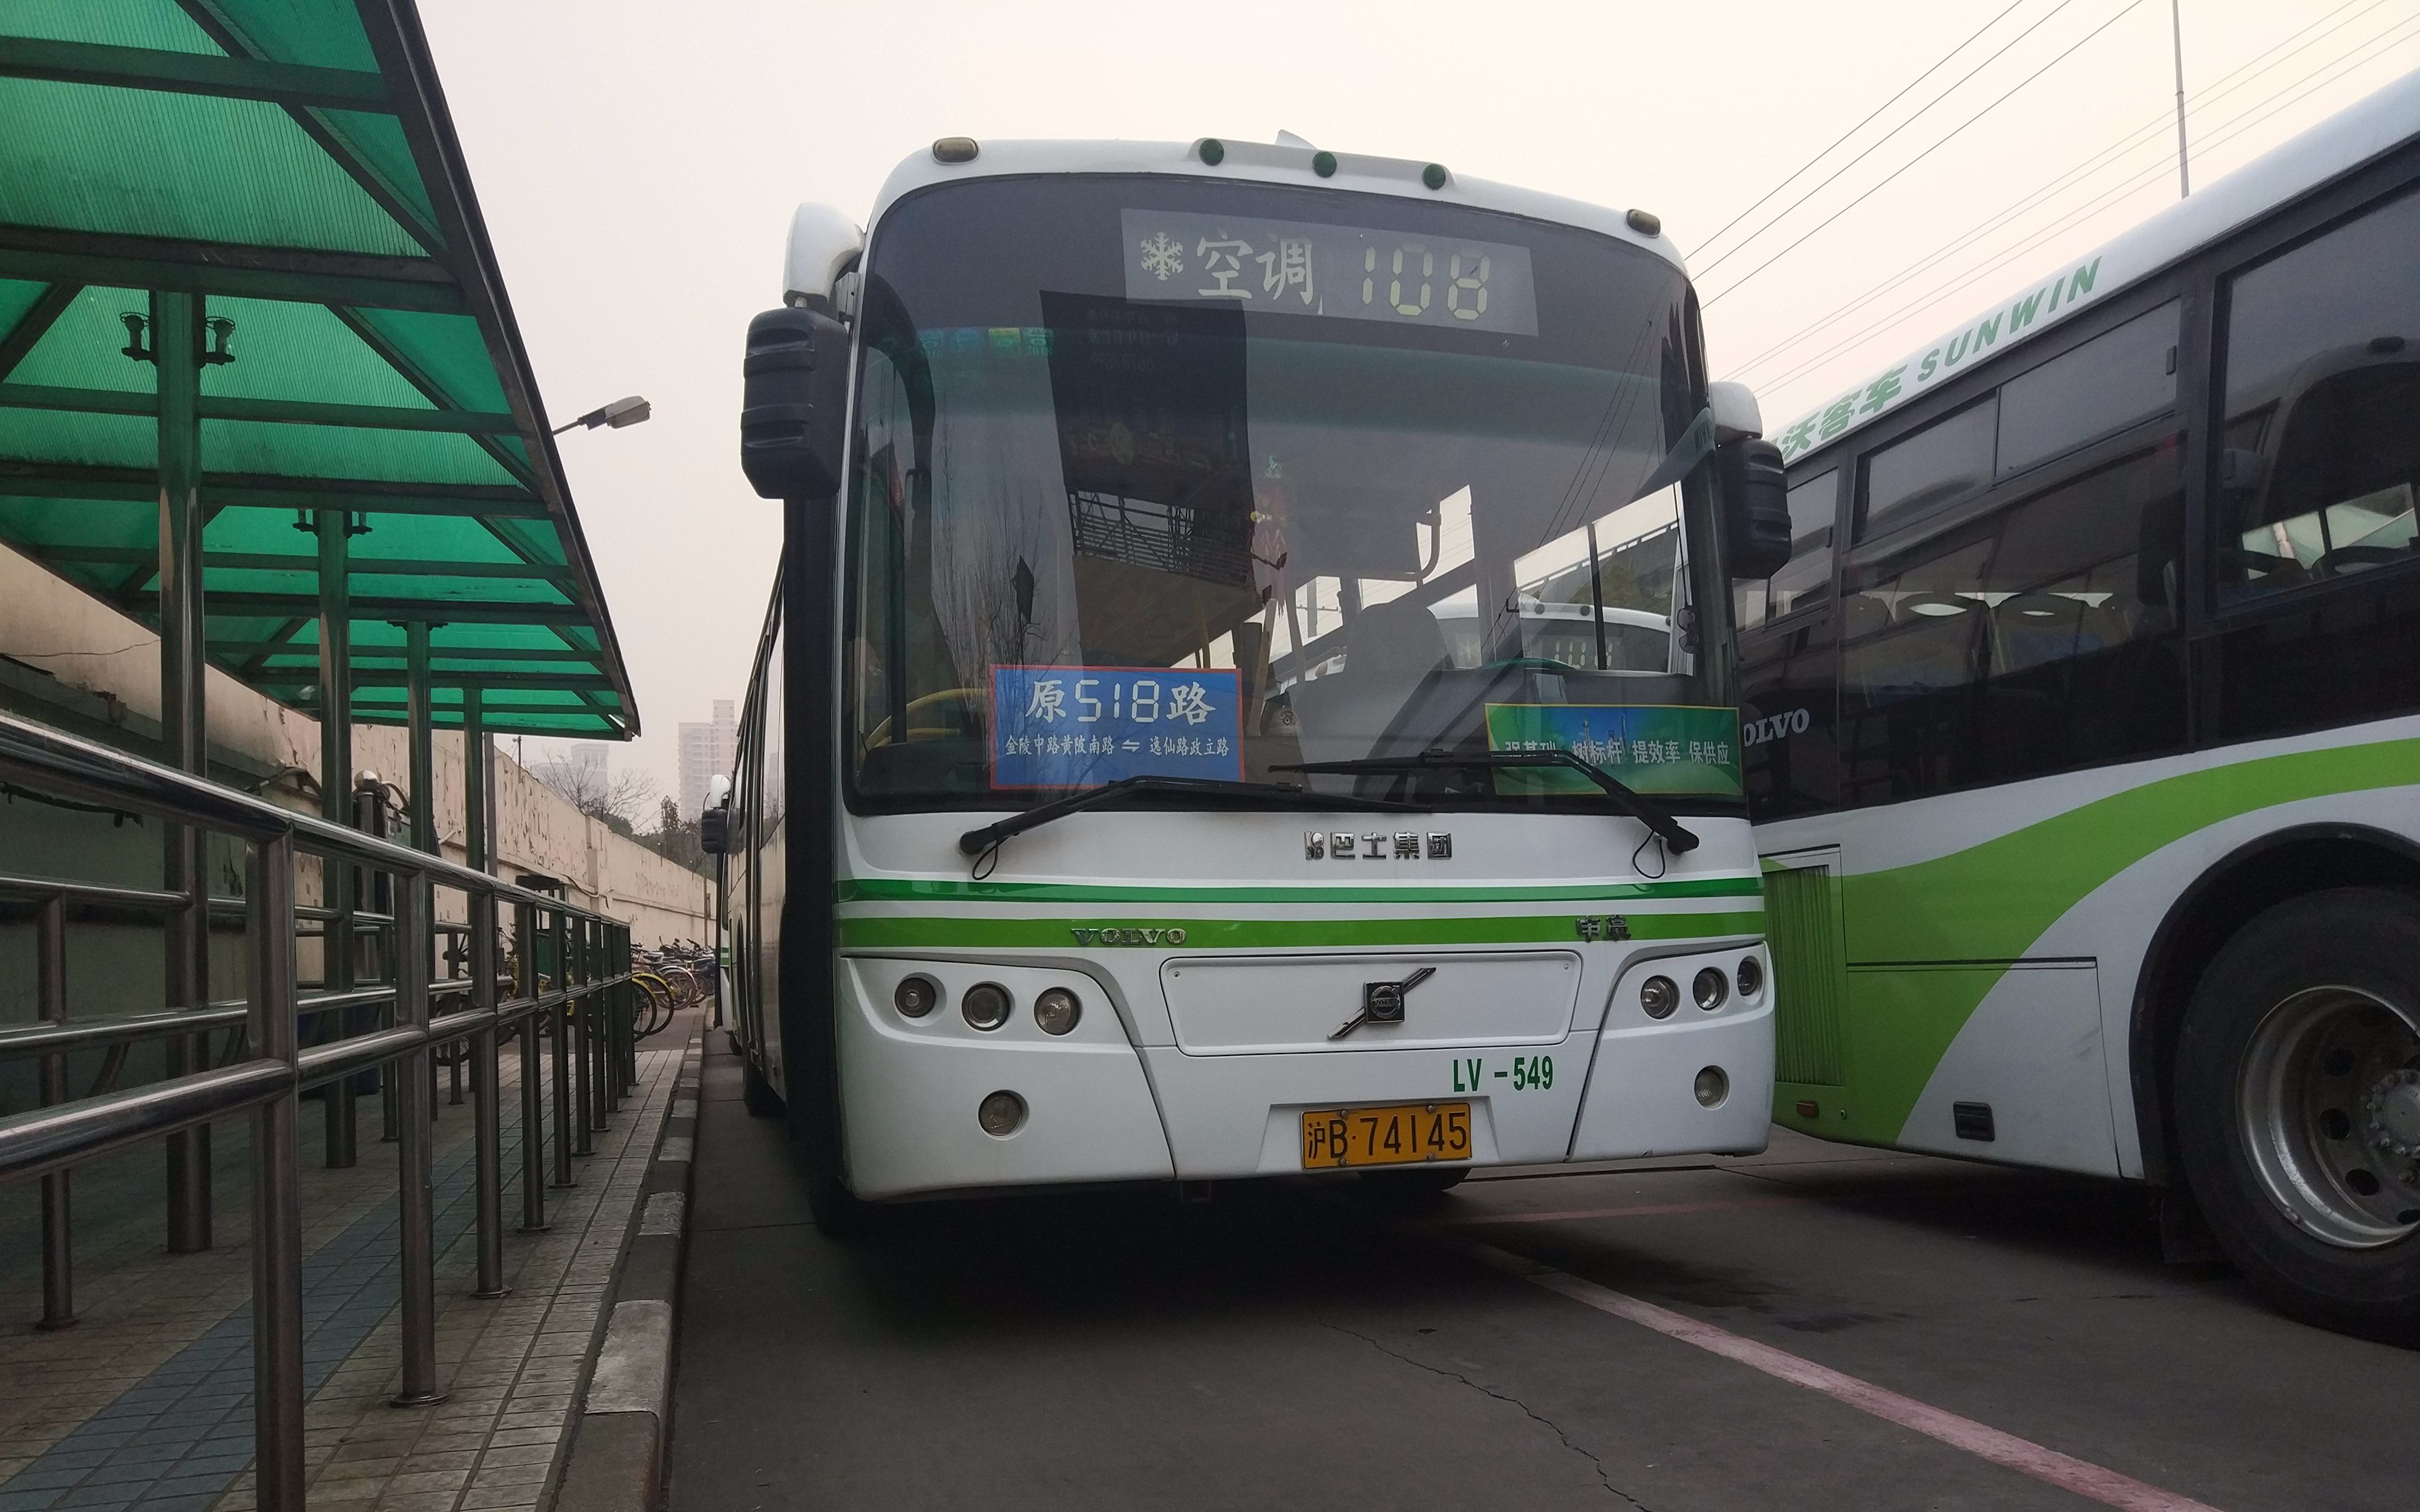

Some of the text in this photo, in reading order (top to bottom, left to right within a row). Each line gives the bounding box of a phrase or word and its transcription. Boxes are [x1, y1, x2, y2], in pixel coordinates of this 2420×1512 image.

[1197, 229, 1490, 321] 空调 108
[1768, 255, 2102, 461] 沃客车 SUNWIN
[1025, 679, 1215, 726] 原518路
[1005, 734, 1229, 757] 金陵中路黄陂南路 逸仙路政立路
[1572, 740, 1623, 764] 树标杆
[1632, 740, 1681, 764] 提效率
[1689, 740, 1730, 765] 保供应
[1071, 928, 1186, 945] VOLVO
